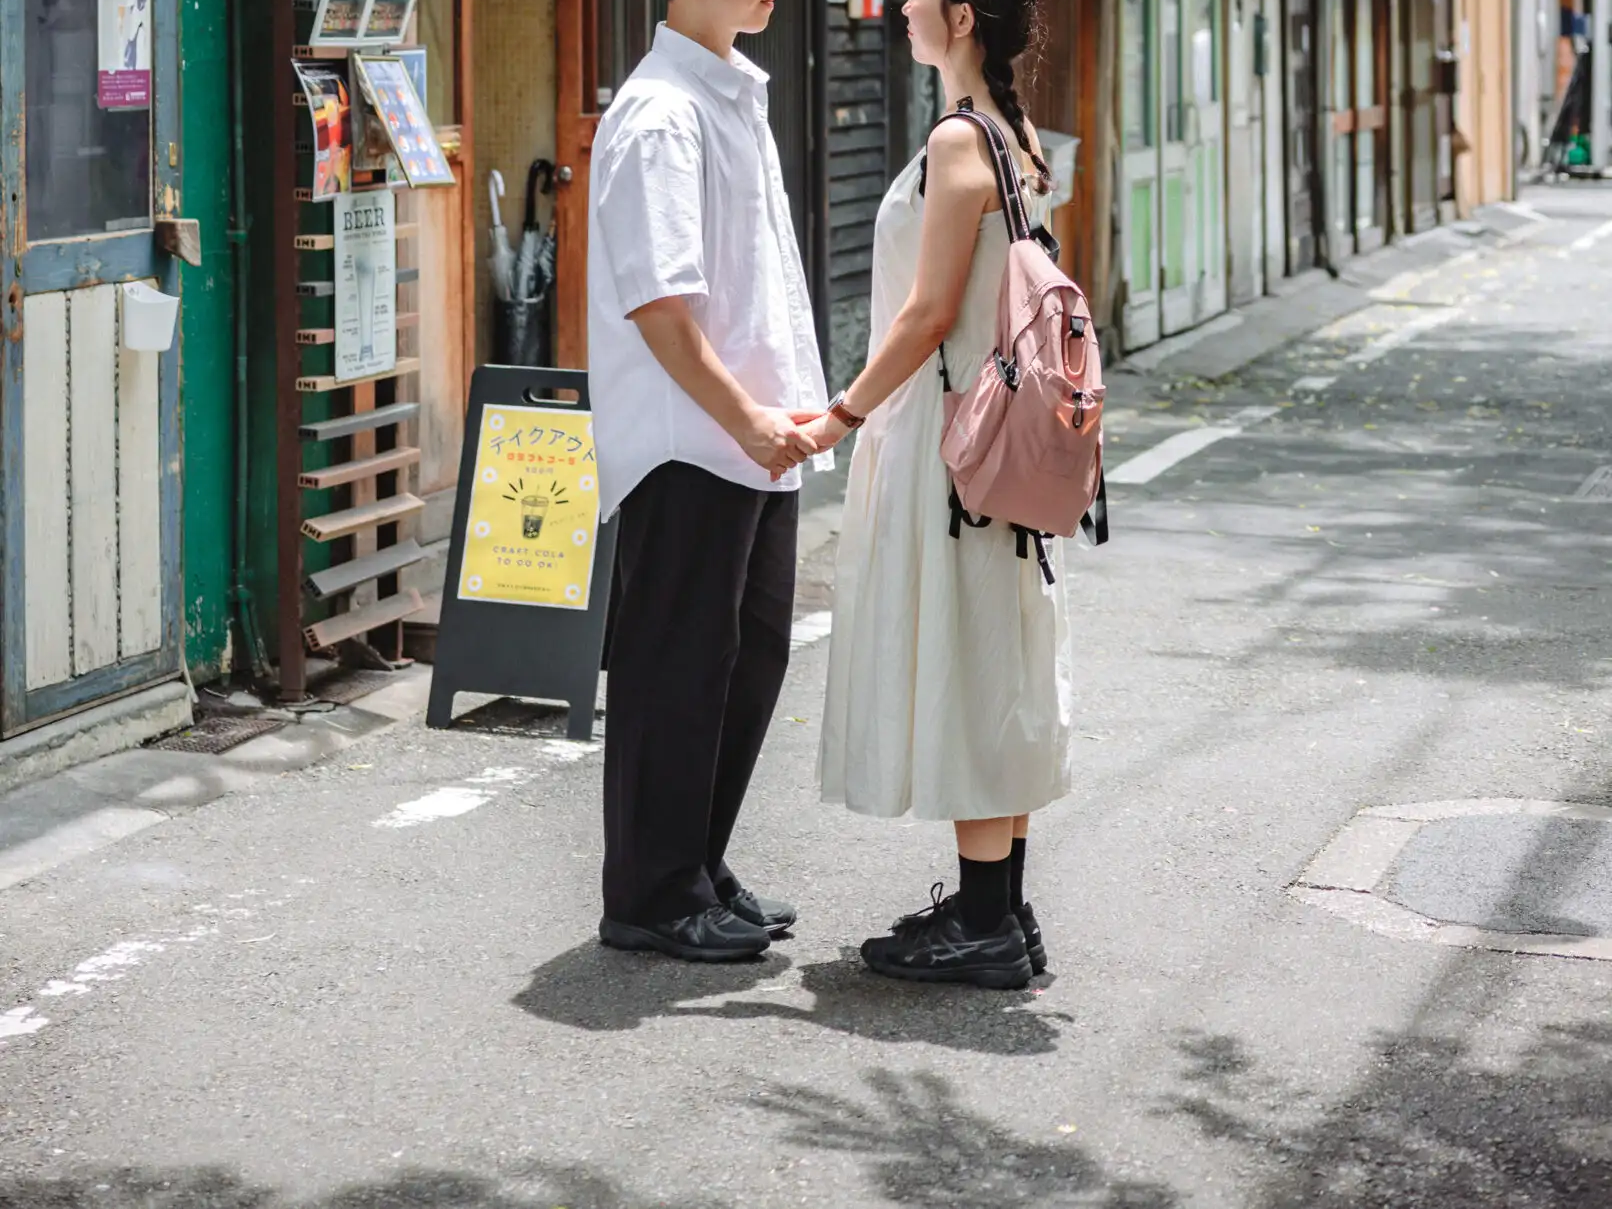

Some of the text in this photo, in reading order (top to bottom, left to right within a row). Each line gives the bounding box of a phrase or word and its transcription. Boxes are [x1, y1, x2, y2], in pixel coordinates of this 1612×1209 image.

[343, 207, 385, 231] BEER
[492, 545, 565, 559] CRAFT COLA
[497, 557, 511, 566] TO
